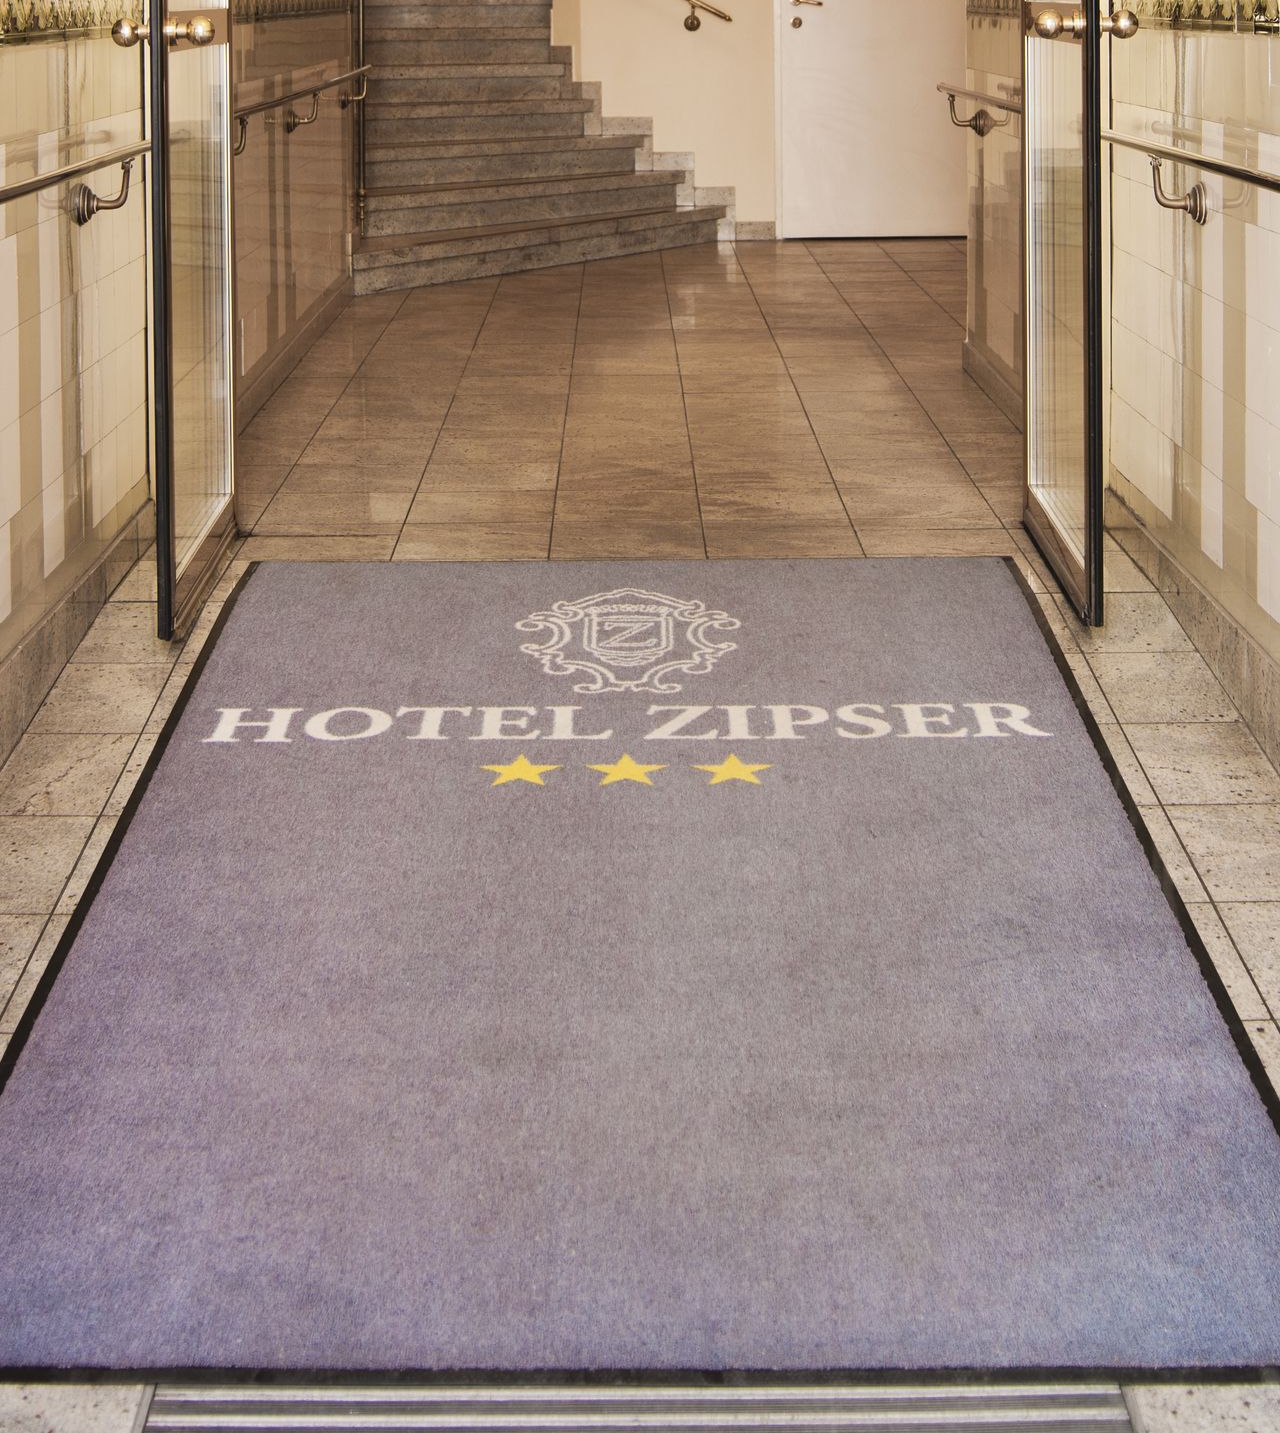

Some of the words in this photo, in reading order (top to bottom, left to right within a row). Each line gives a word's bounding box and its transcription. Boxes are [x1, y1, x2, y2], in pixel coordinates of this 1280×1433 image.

[599, 621, 657, 648] Z
[202, 705, 613, 744] HOTEL
[643, 702, 1054, 741] ZIPSER
